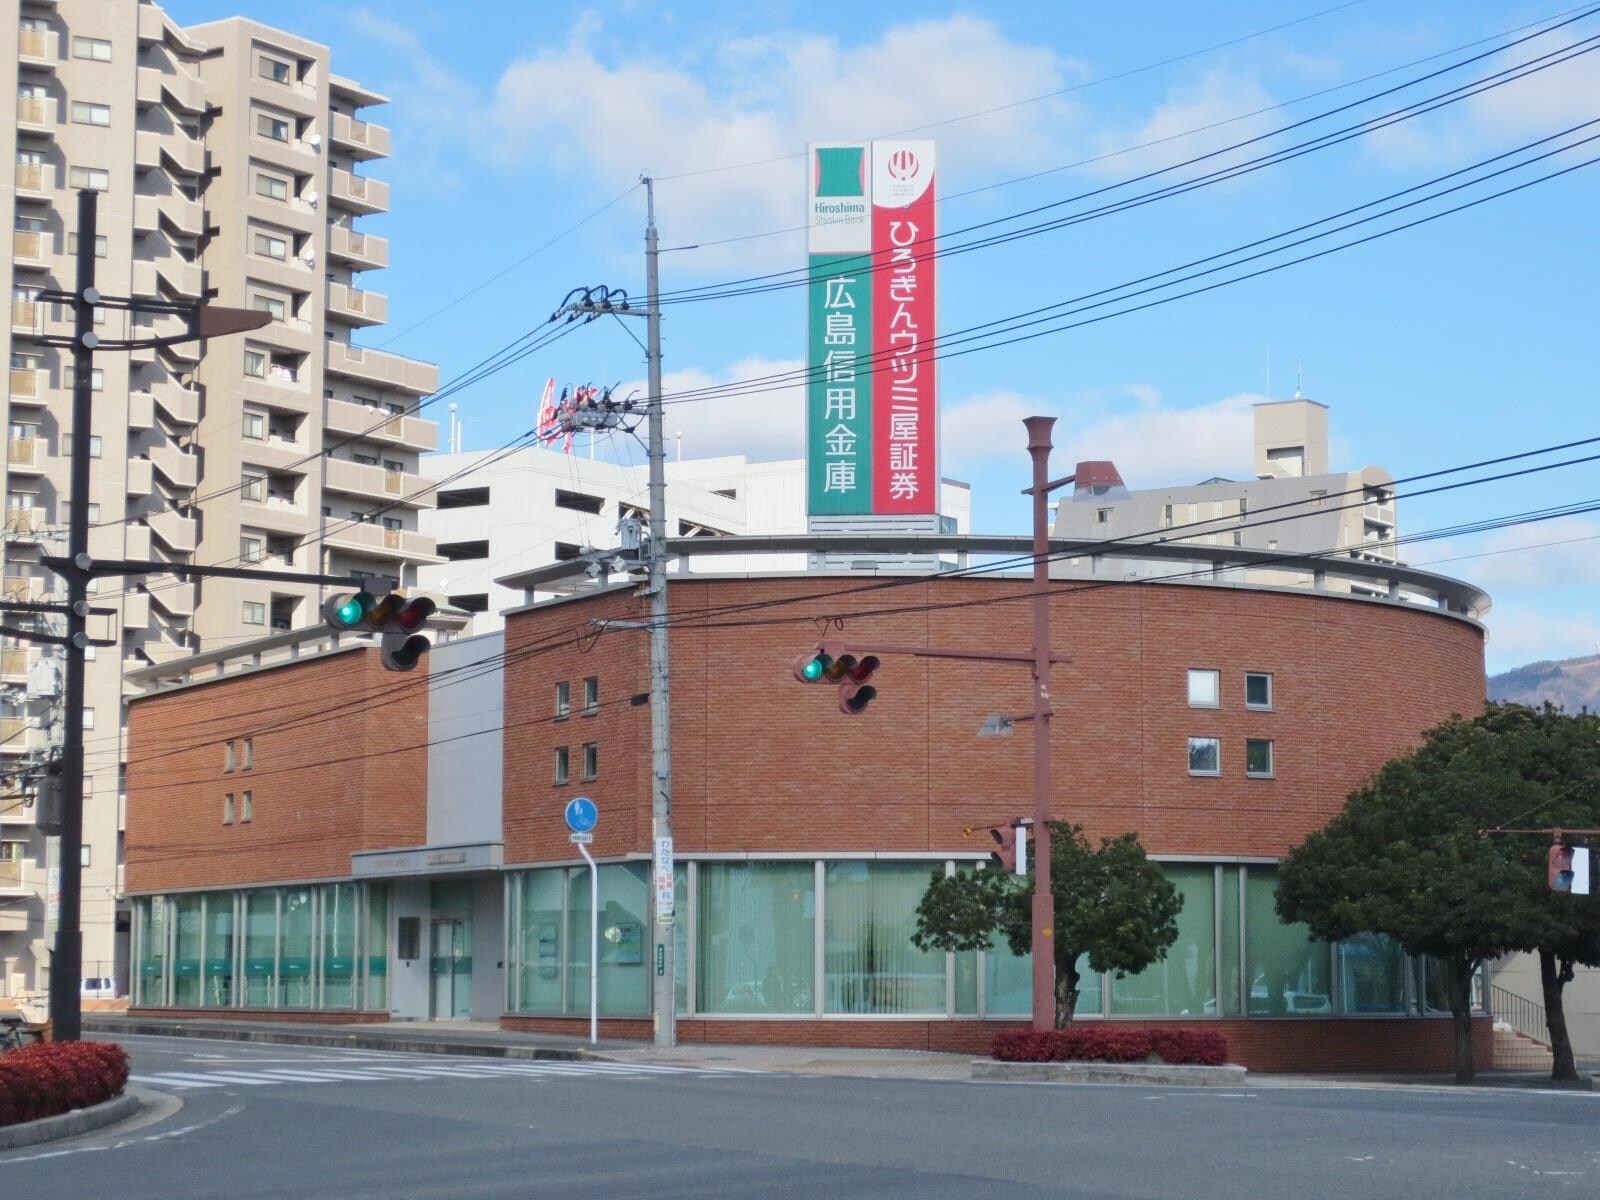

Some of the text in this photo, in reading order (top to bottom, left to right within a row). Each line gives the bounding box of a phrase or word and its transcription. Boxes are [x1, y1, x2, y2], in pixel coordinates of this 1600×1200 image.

[815, 202, 864, 213] Hiroshima
[824, 276, 857, 494] 広島信用金庫
[889, 221, 919, 500] ひろぎんウツミ屋証券
